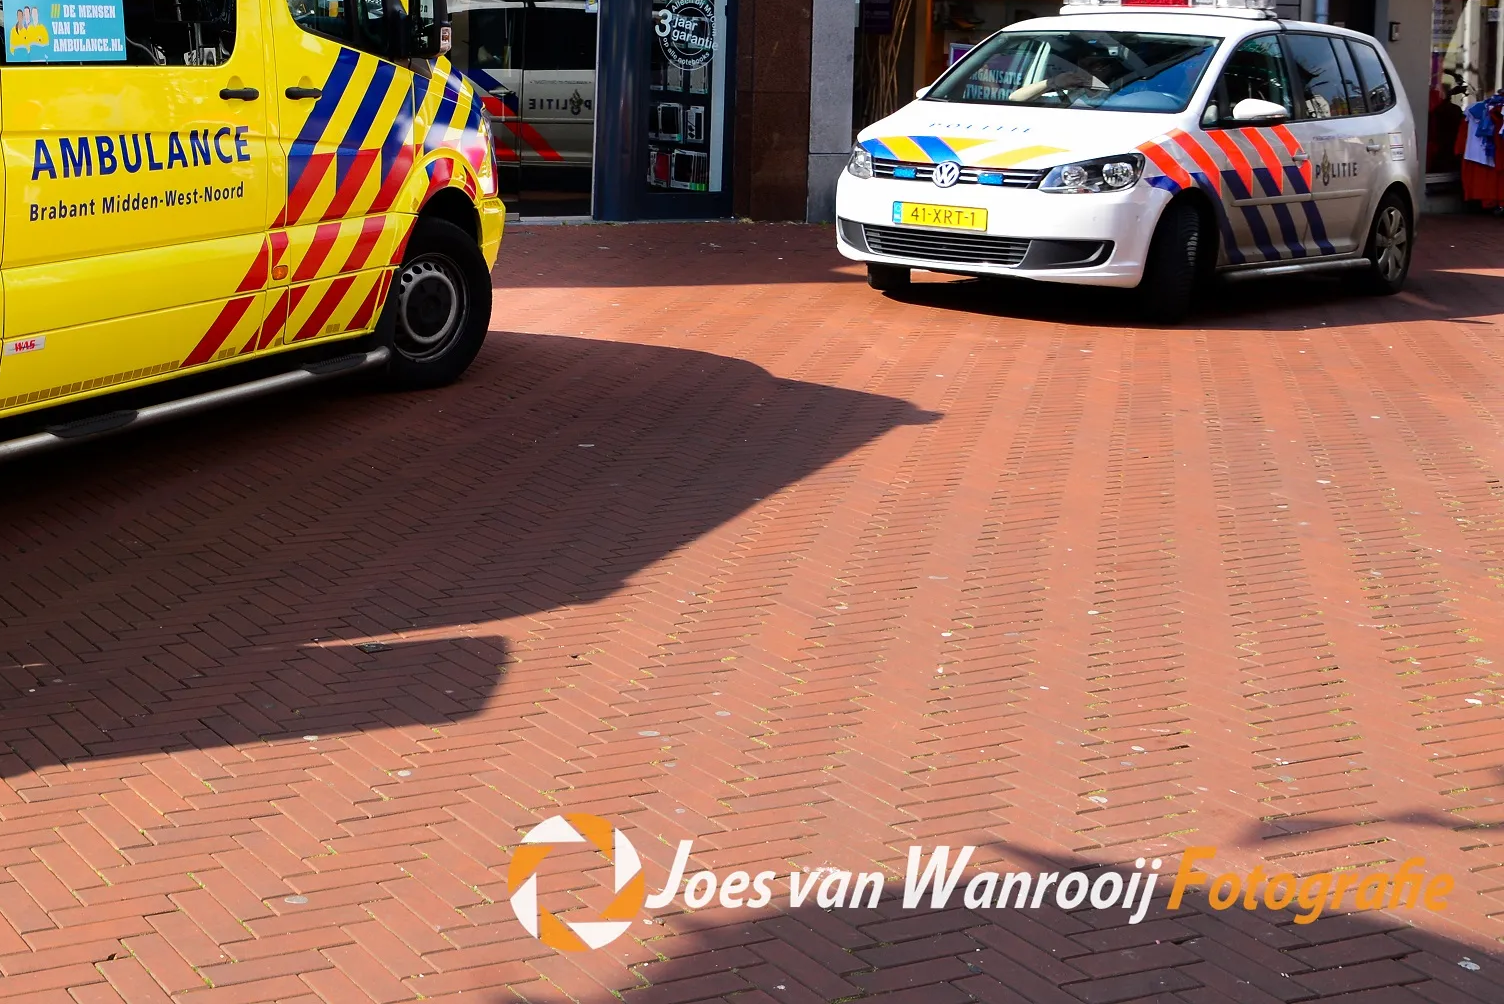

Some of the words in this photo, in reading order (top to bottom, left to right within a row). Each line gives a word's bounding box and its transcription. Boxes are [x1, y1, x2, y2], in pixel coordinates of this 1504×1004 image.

[63, 4, 76, 18] DE
[79, 5, 115, 18] MENSEN
[52, 22, 70, 35] VAN
[74, 22, 86, 35] DE
[655, 9, 672, 37] 3
[672, 14, 698, 31] jaar
[53, 38, 123, 52] AMBULANCE.NL
[671, 29, 718, 51] garantie
[31, 126, 251, 181] AMBULANCE
[29, 199, 96, 222] Brabant
[102, 181, 244, 215] Midden-West-Noord
[911, 207, 975, 226] 41-XRT-1
[15, 340, 35, 352] WAS
